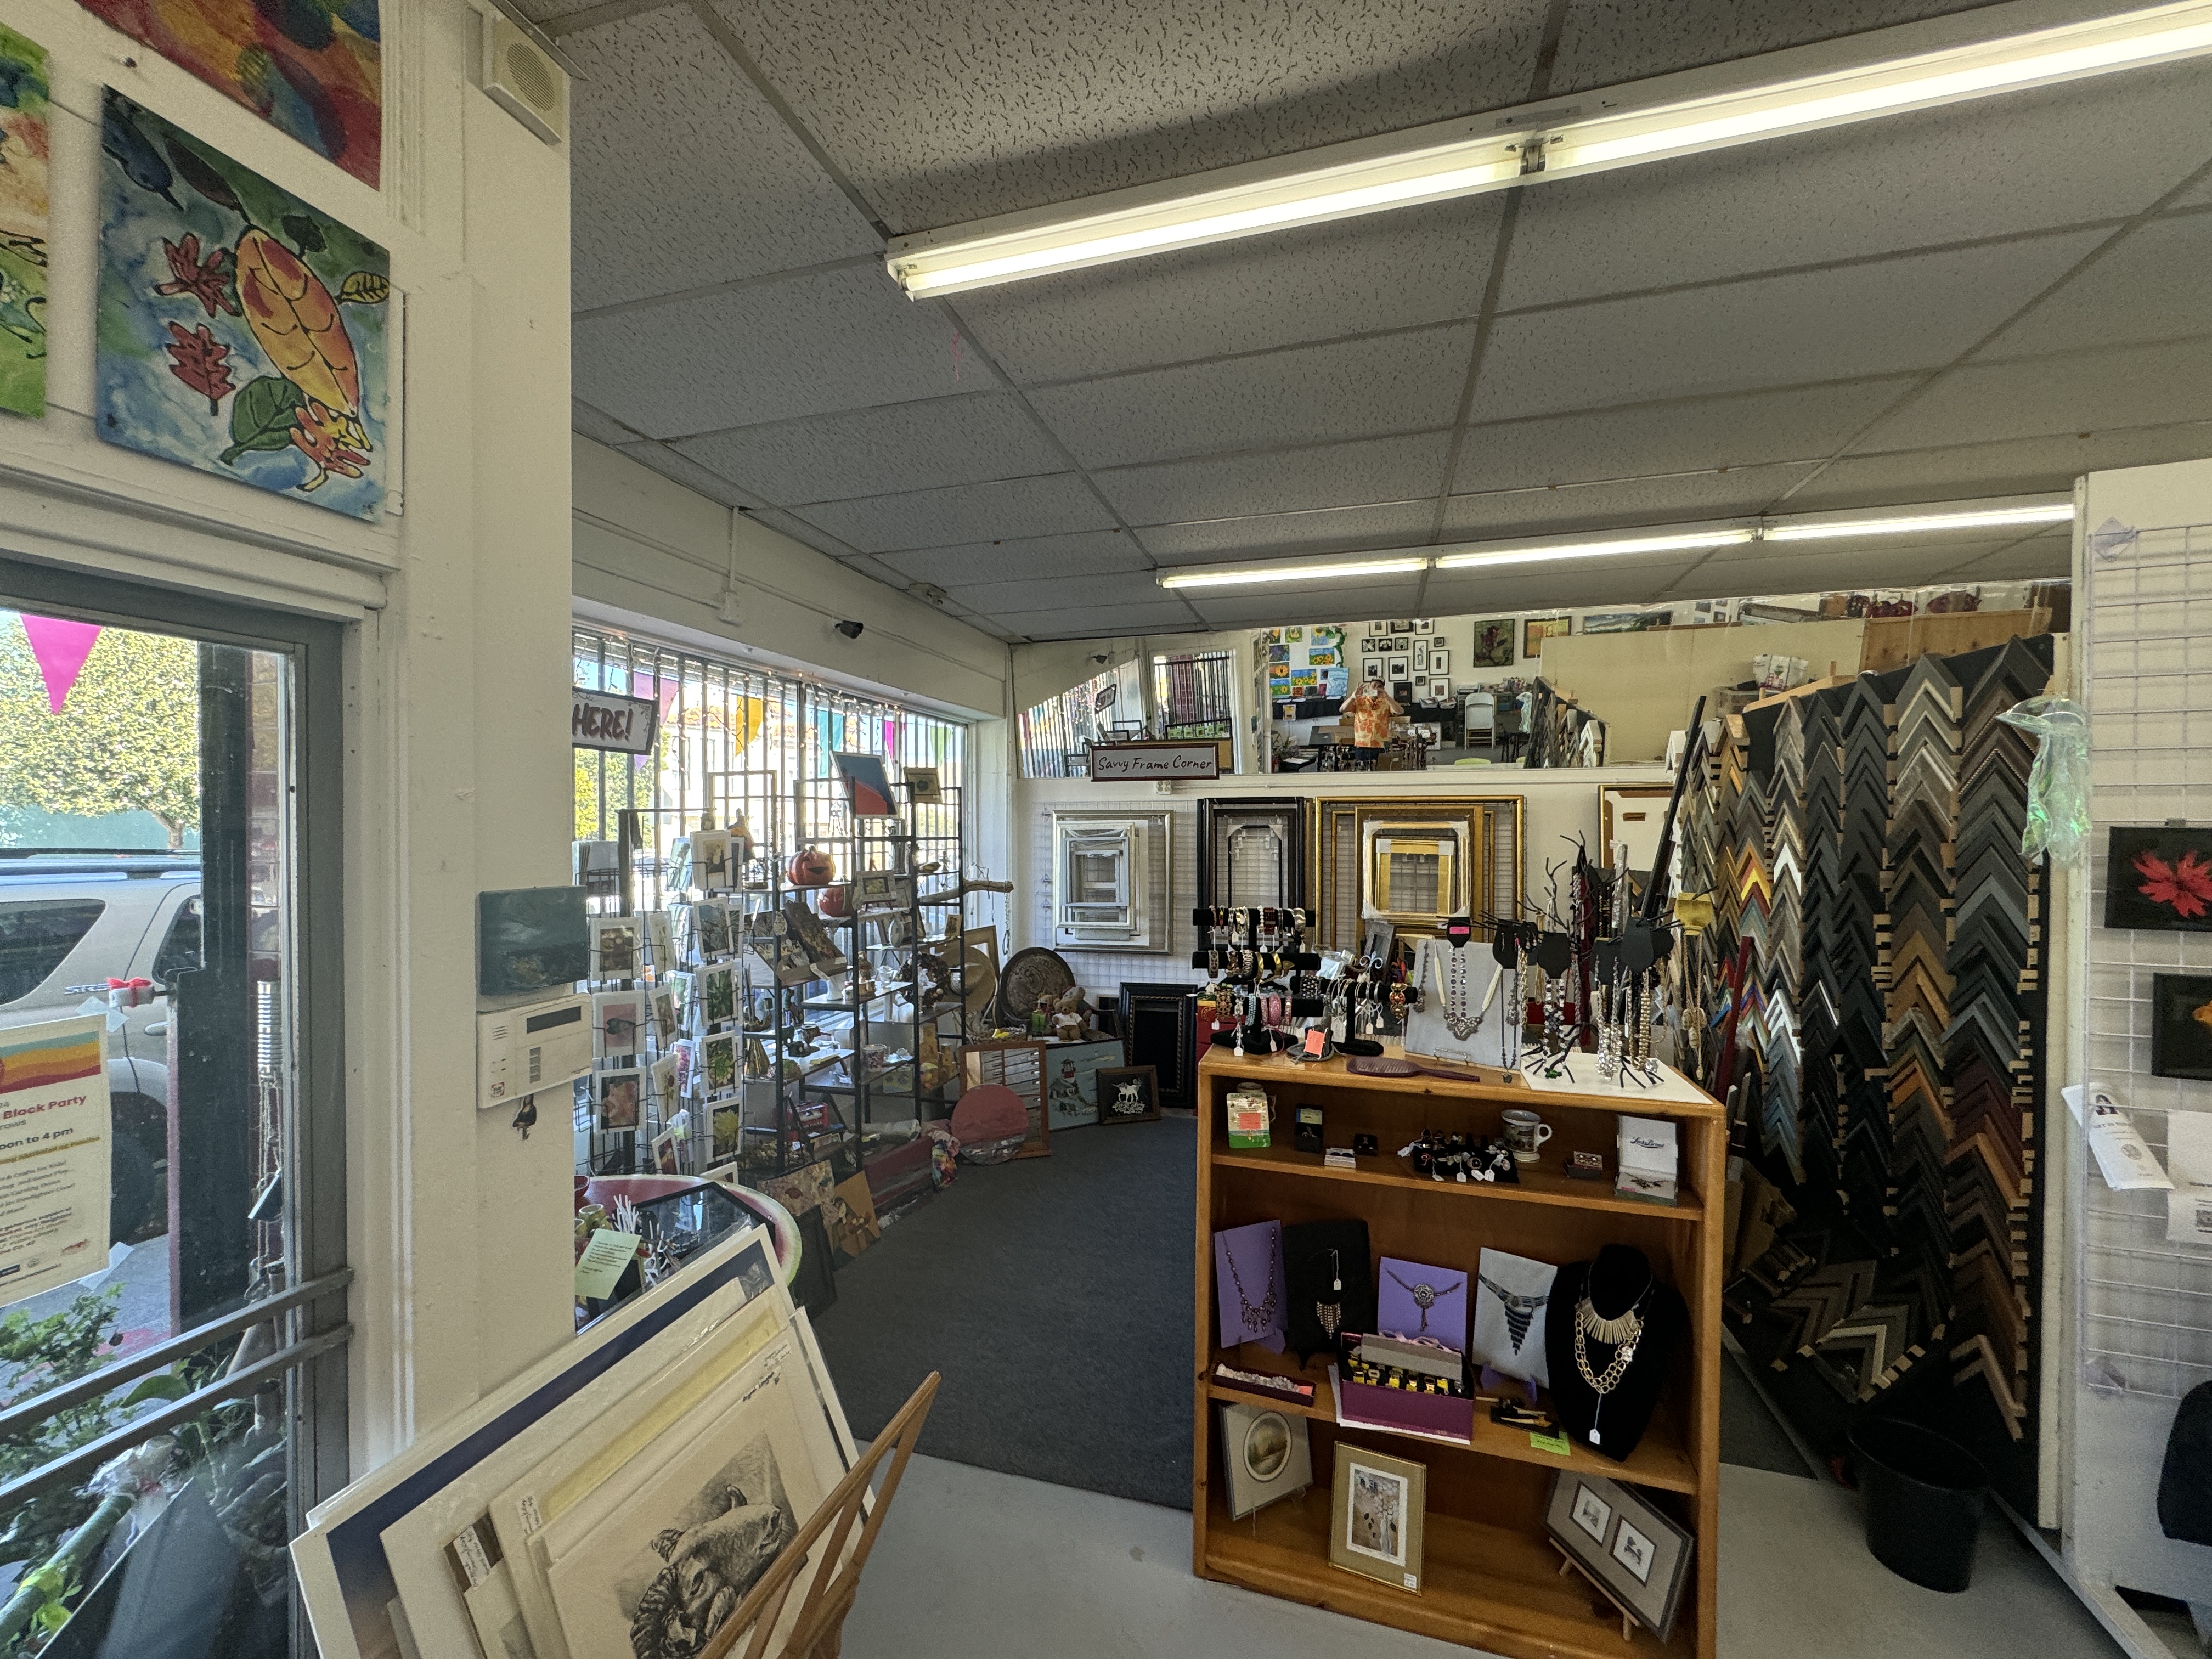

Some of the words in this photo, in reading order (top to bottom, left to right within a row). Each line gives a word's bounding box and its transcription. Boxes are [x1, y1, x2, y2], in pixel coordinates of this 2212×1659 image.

[572, 703, 634, 742] HERE!
[1098, 757, 1128, 772] Savvy
[1132, 757, 1169, 769] Frame
[1173, 755, 1212, 768] Corner
[3, 1104, 45, 1119] Block
[48, 1095, 87, 1110] Party
[53, 1128, 74, 1139] pm
